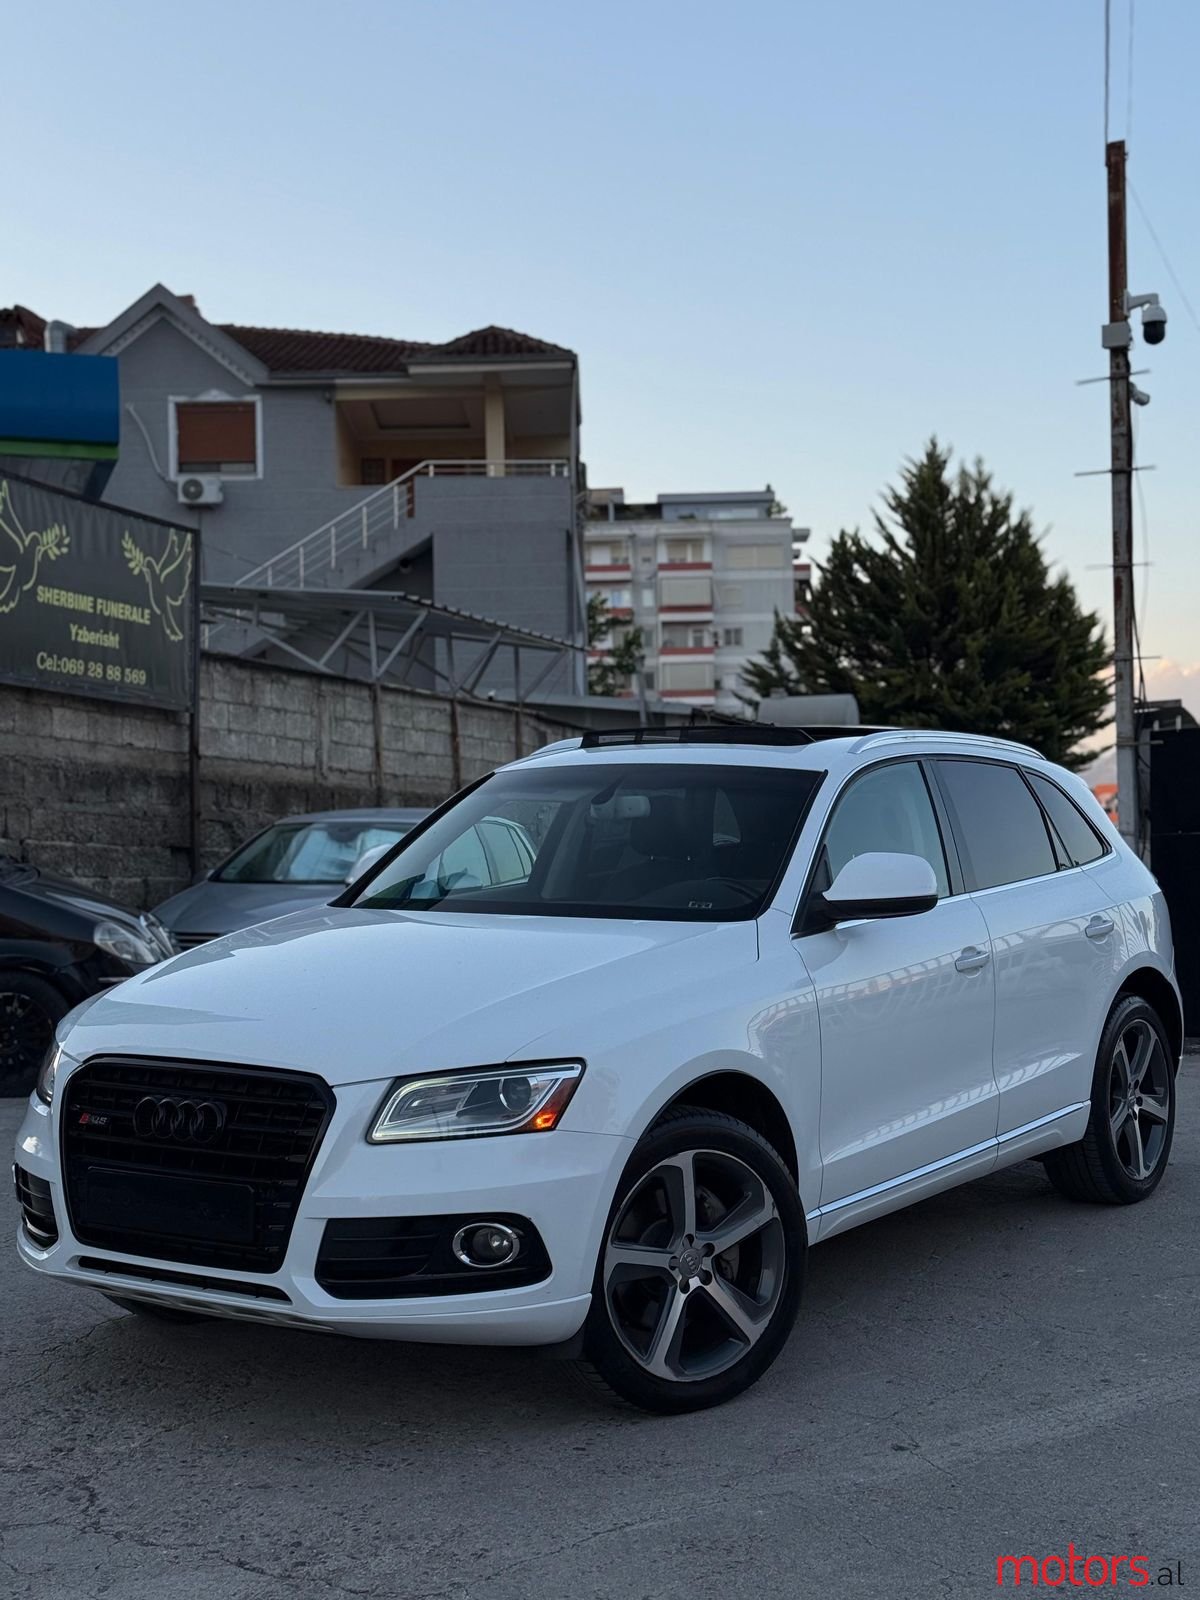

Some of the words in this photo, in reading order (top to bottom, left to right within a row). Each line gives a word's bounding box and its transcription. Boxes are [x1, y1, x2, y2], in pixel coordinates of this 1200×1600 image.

[36, 586, 94, 613] SHERBIME
[96, 599, 151, 625] FUNERALE
[69, 624, 120, 649] Yzberisht
[36, 652, 85, 676] Cel:069
[87, 662, 104, 678] 28
[106, 666, 121, 682] 88
[124, 669, 147, 685] 569
